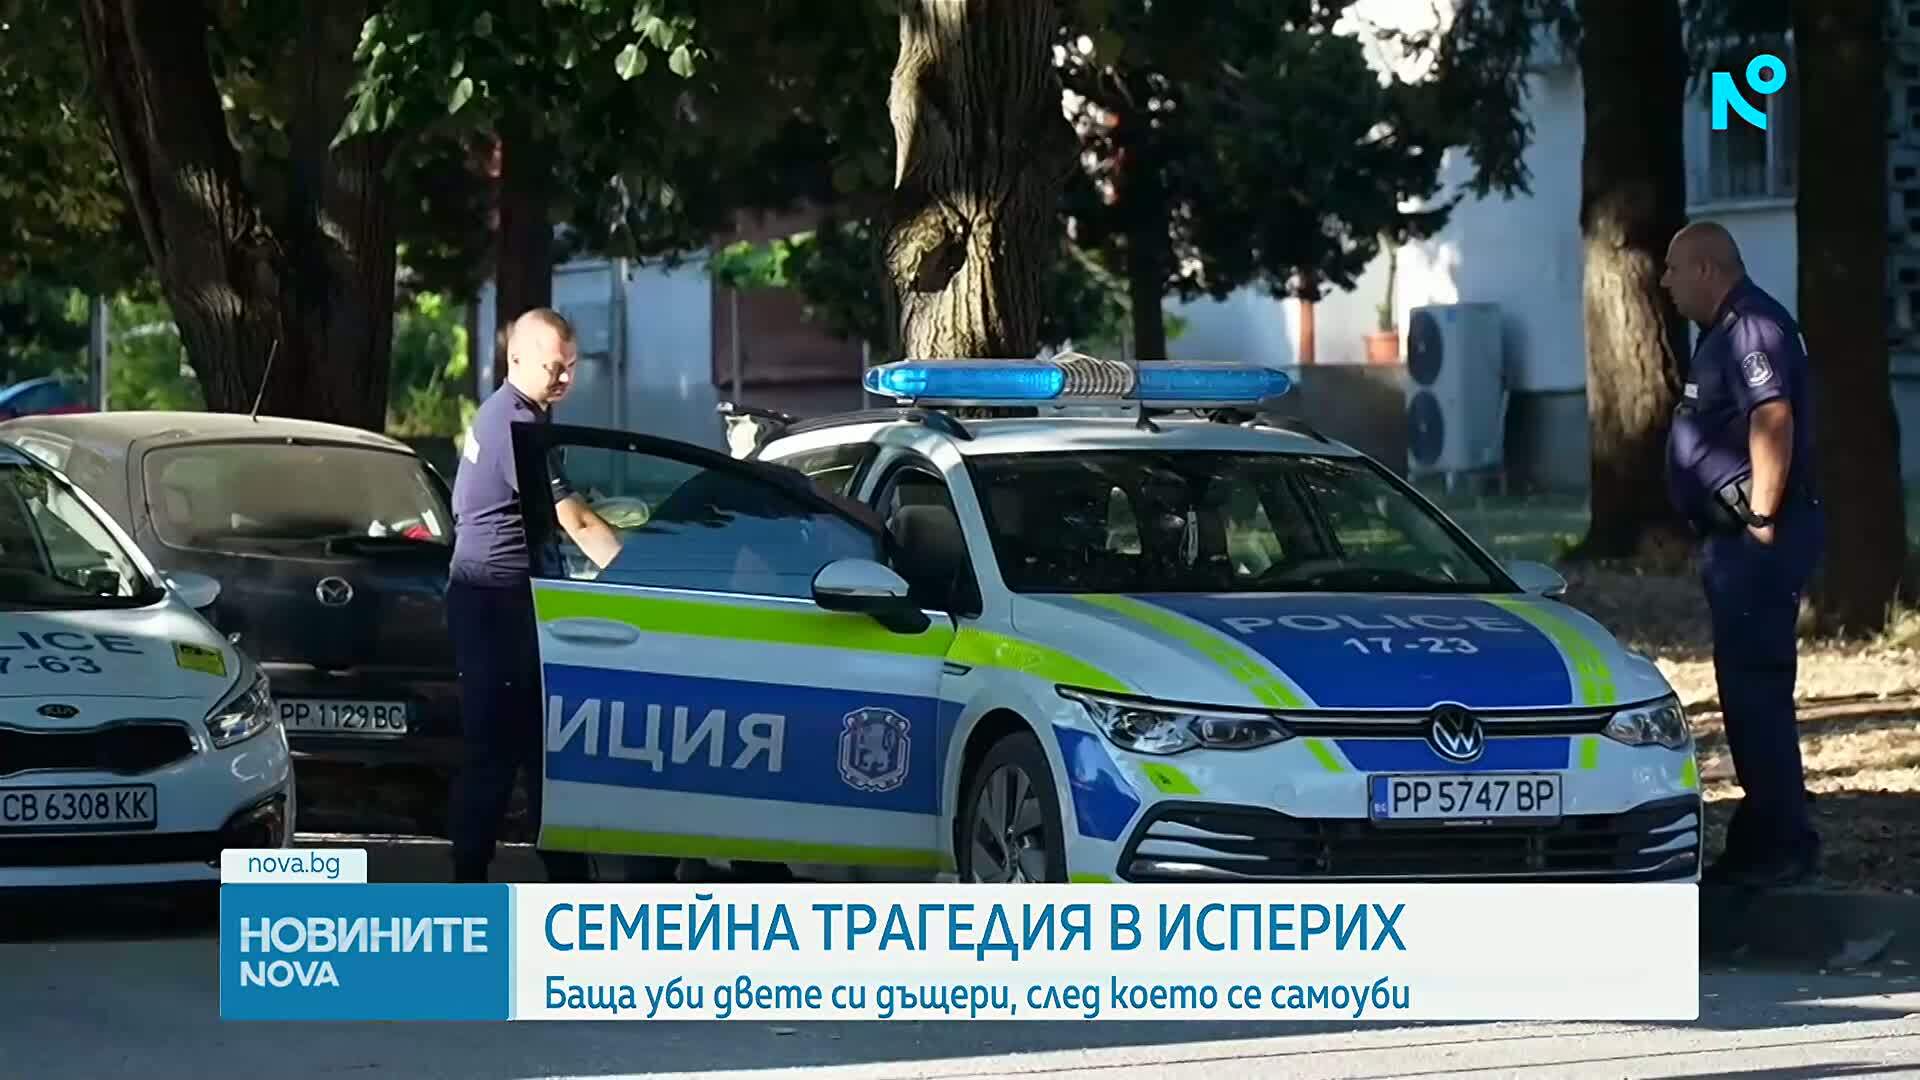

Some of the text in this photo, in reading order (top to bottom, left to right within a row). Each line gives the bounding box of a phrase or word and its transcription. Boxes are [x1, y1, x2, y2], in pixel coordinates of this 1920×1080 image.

[1221, 615, 1525, 634] POLICE
[1343, 637, 1479, 655] 17-23
[280, 703, 402, 730] PP 1129 BC
[547, 695, 785, 773] ИЦИЯ
[3, 791, 149, 821] CB 6308 KK
[1393, 780, 1554, 813] PP 5747 BP
